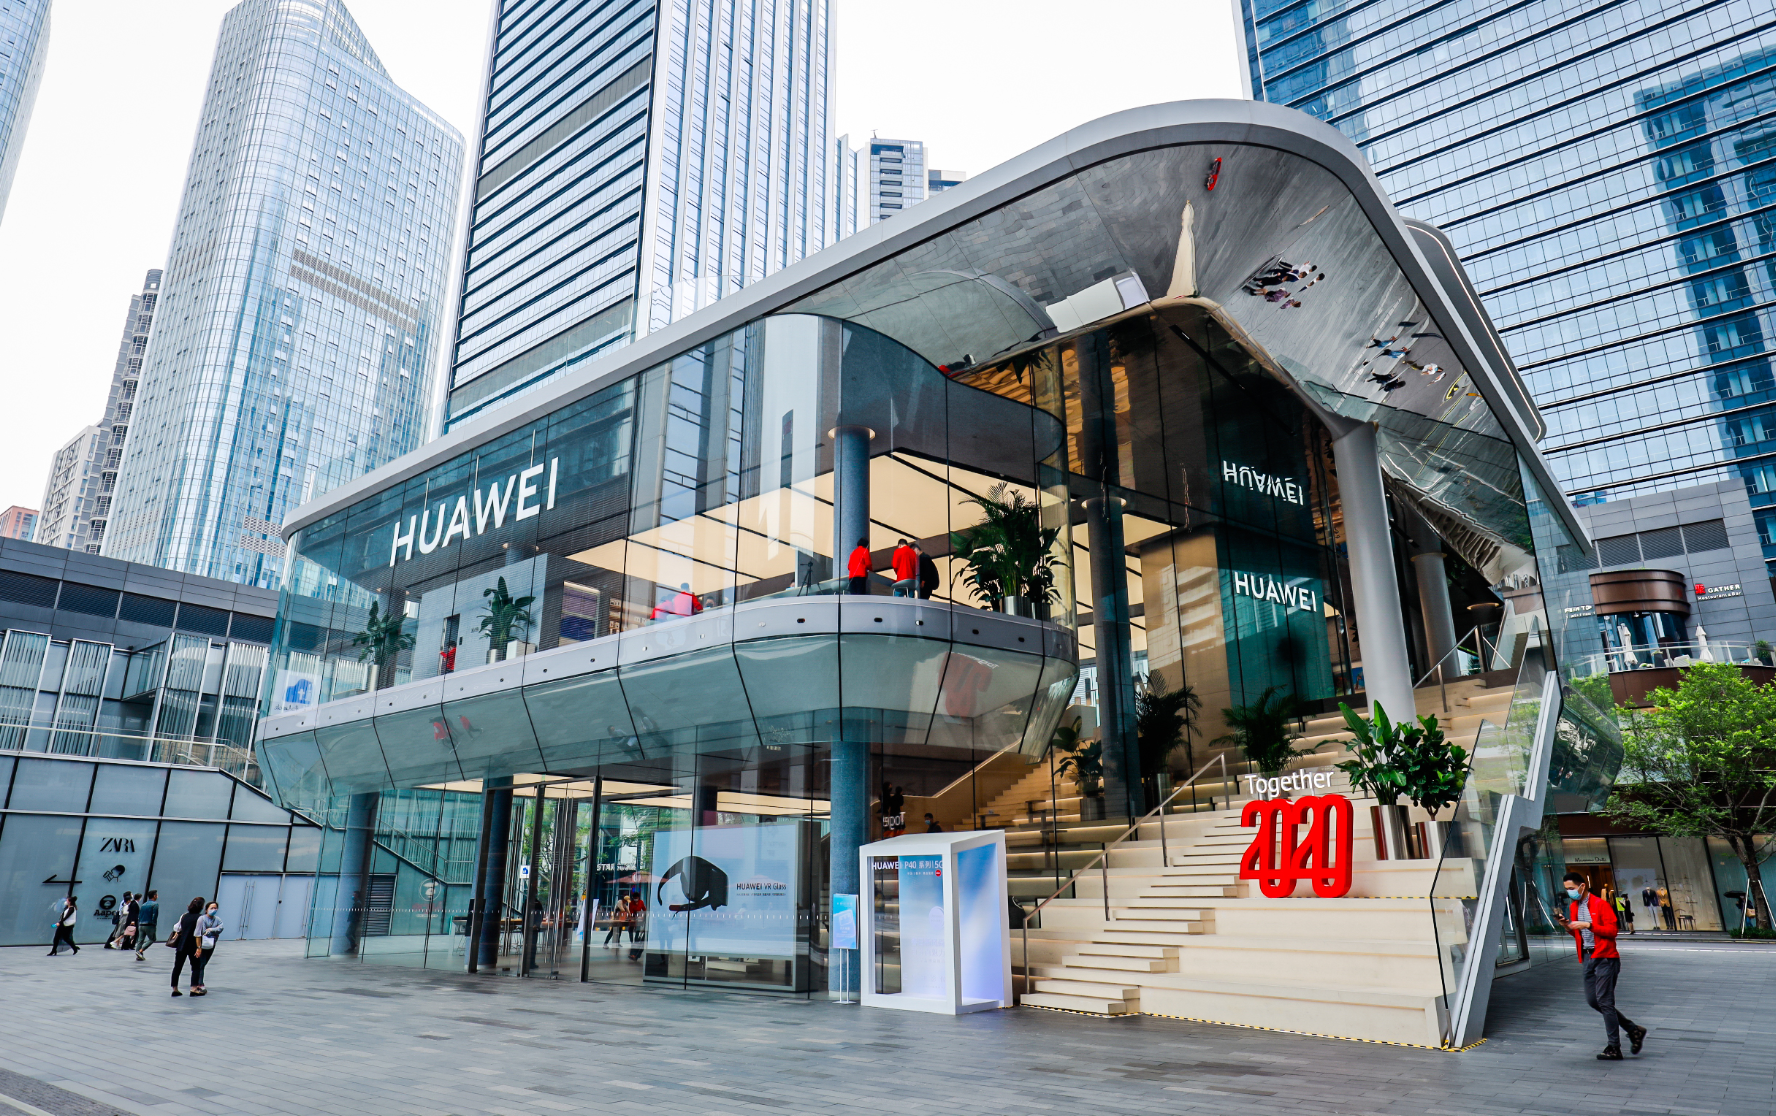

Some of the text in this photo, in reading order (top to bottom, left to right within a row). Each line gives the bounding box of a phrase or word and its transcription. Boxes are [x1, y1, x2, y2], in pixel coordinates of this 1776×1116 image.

[389, 456, 559, 568] HUAWEI
[1234, 571, 1317, 612] HUAWEI
[1707, 583, 1741, 594] GATHER
[1244, 768, 1335, 798] Together
[100, 837, 135, 853] ZARA
[1239, 794, 1354, 899] 2020
[871, 860, 902, 871] HUAWEI
[904, 860, 917, 869] P40
[736, 882, 787, 891] HUAWEI VR Glass
